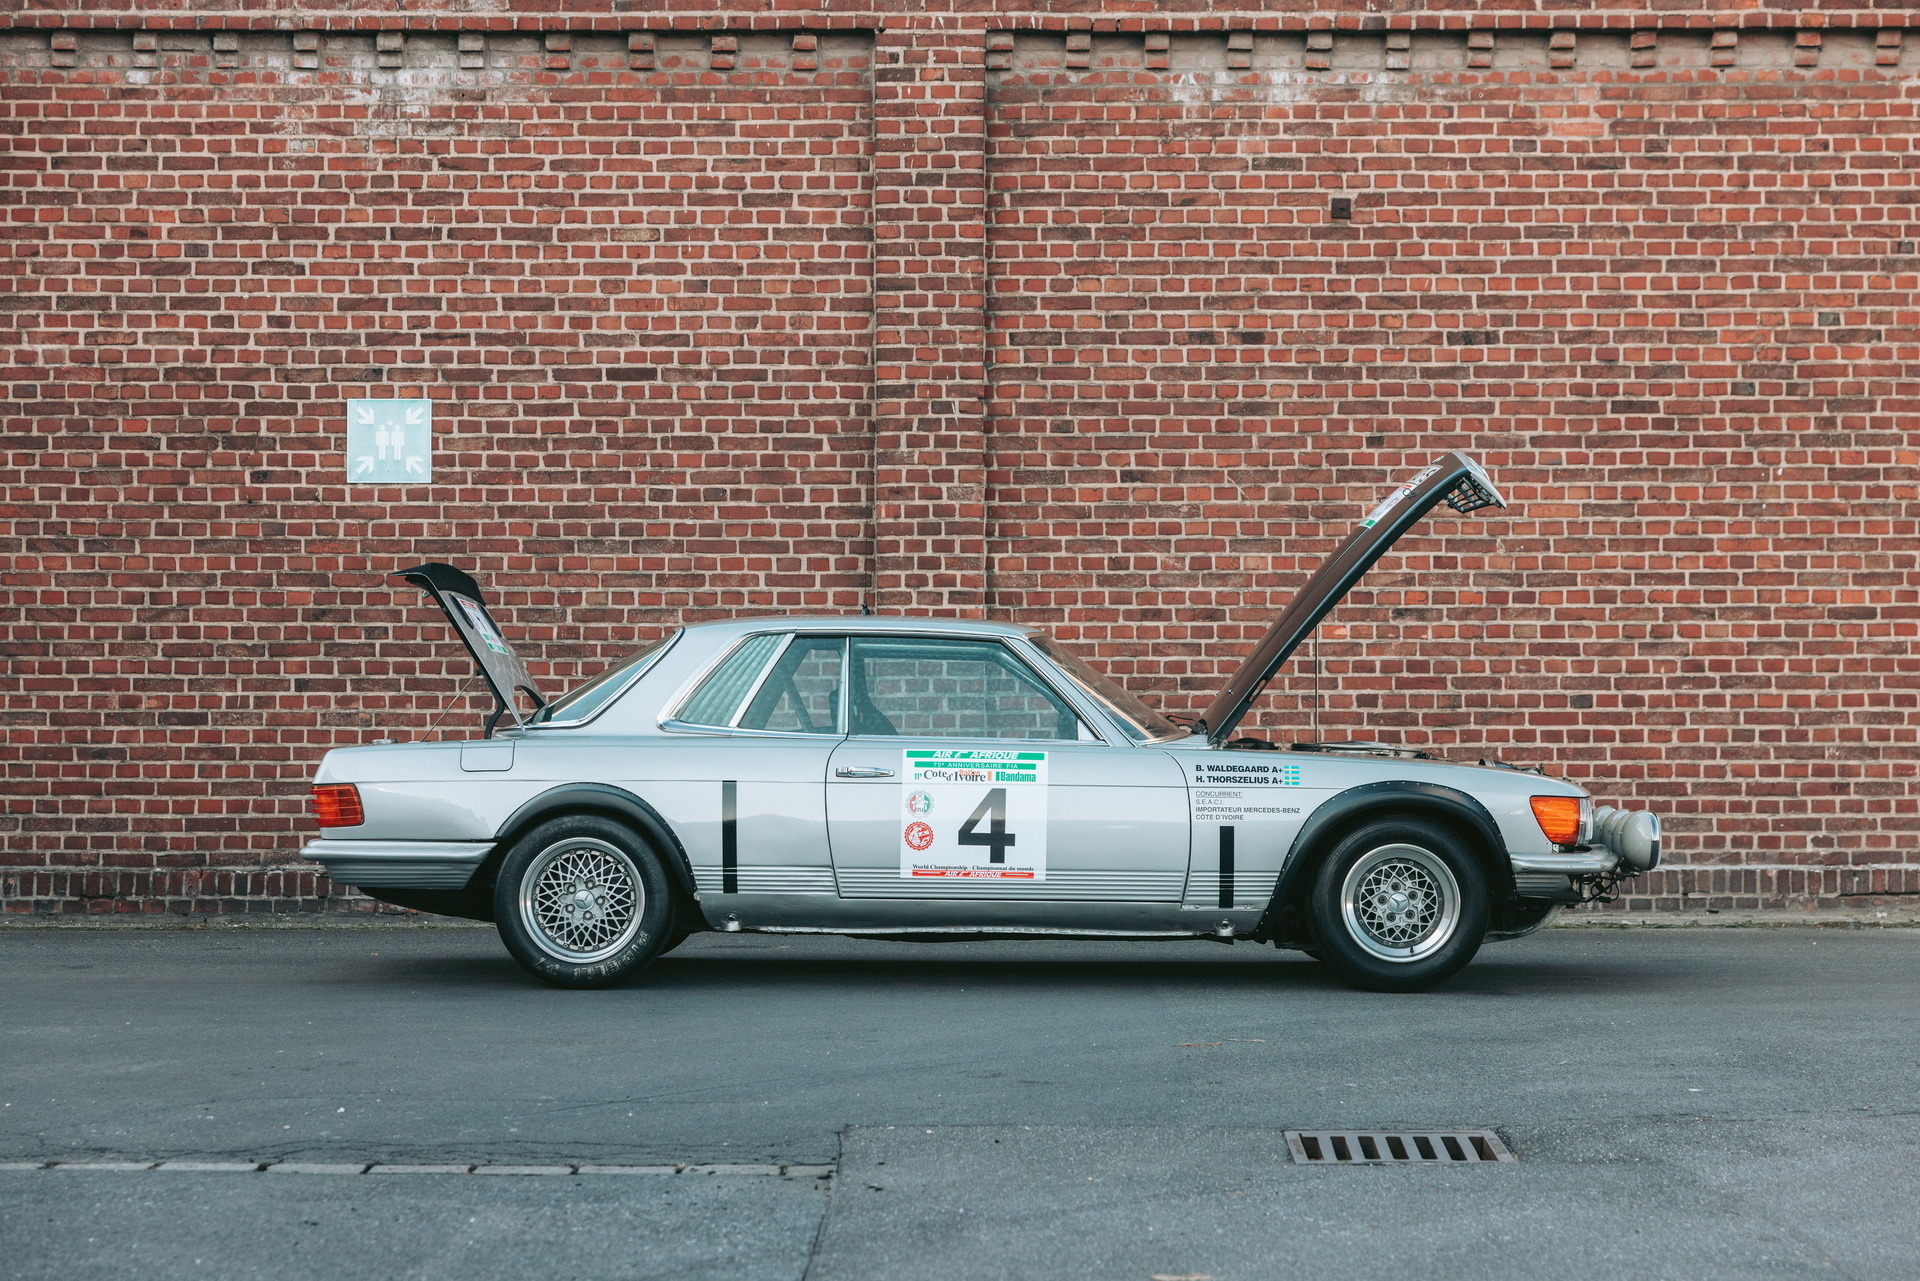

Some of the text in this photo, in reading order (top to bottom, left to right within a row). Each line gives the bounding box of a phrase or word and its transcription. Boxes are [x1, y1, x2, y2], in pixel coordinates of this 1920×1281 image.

[970, 752, 1019, 760] AFRIQUE
[1001, 772, 1036, 782] Bandama
[1206, 776, 1270, 784] THORSZELIUS
[958, 788, 1015, 863] 4
